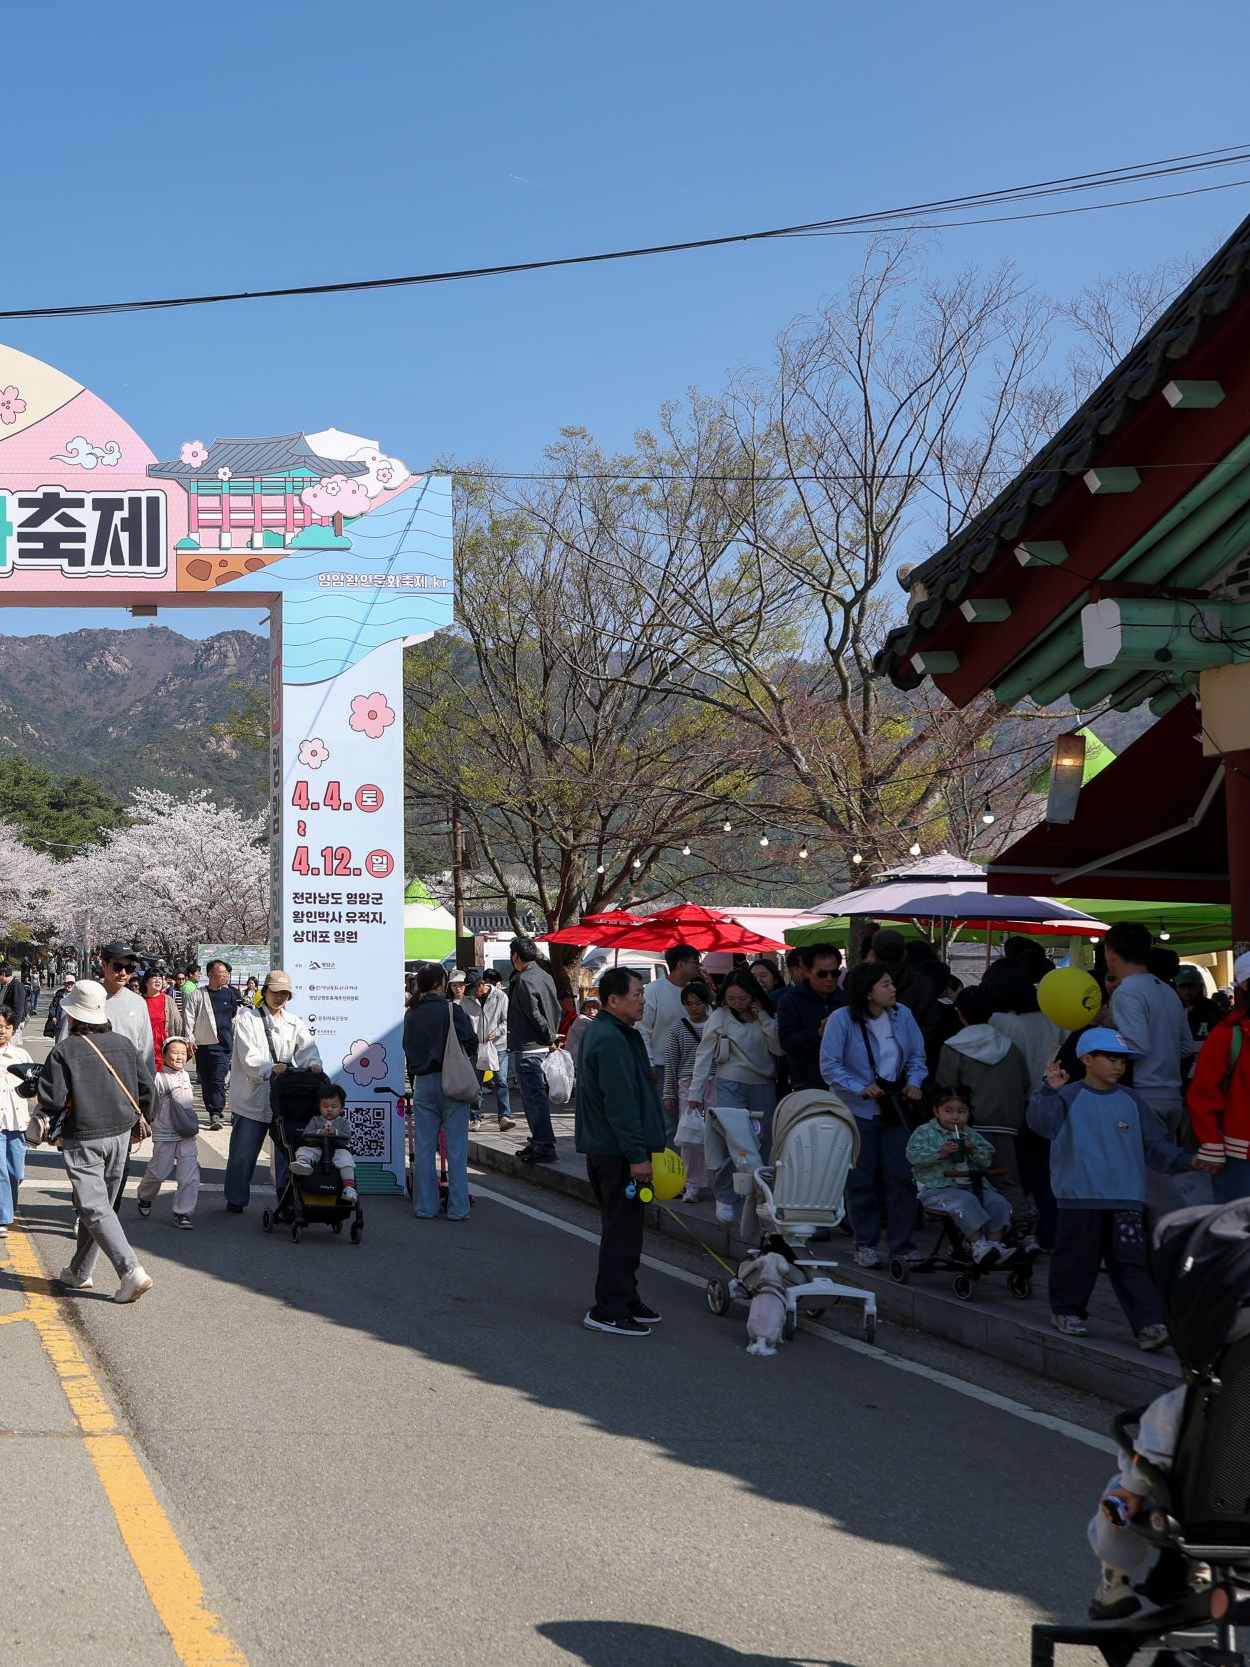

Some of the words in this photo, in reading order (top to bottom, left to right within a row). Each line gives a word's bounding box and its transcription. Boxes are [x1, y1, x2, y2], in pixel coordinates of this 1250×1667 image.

[318, 574, 448, 588] 영암왕인문화축제.kr
[291, 781, 353, 811] 4.4.
[291, 846, 362, 877] 4.12.
[292, 892, 343, 906] 전라남도
[346, 892, 384, 906] 영암군
[292, 911, 343, 924] 왕인박사
[346, 911, 387, 925] 유적지,
[292, 930, 331, 943] 상대포
[334, 930, 359, 944] 일원
